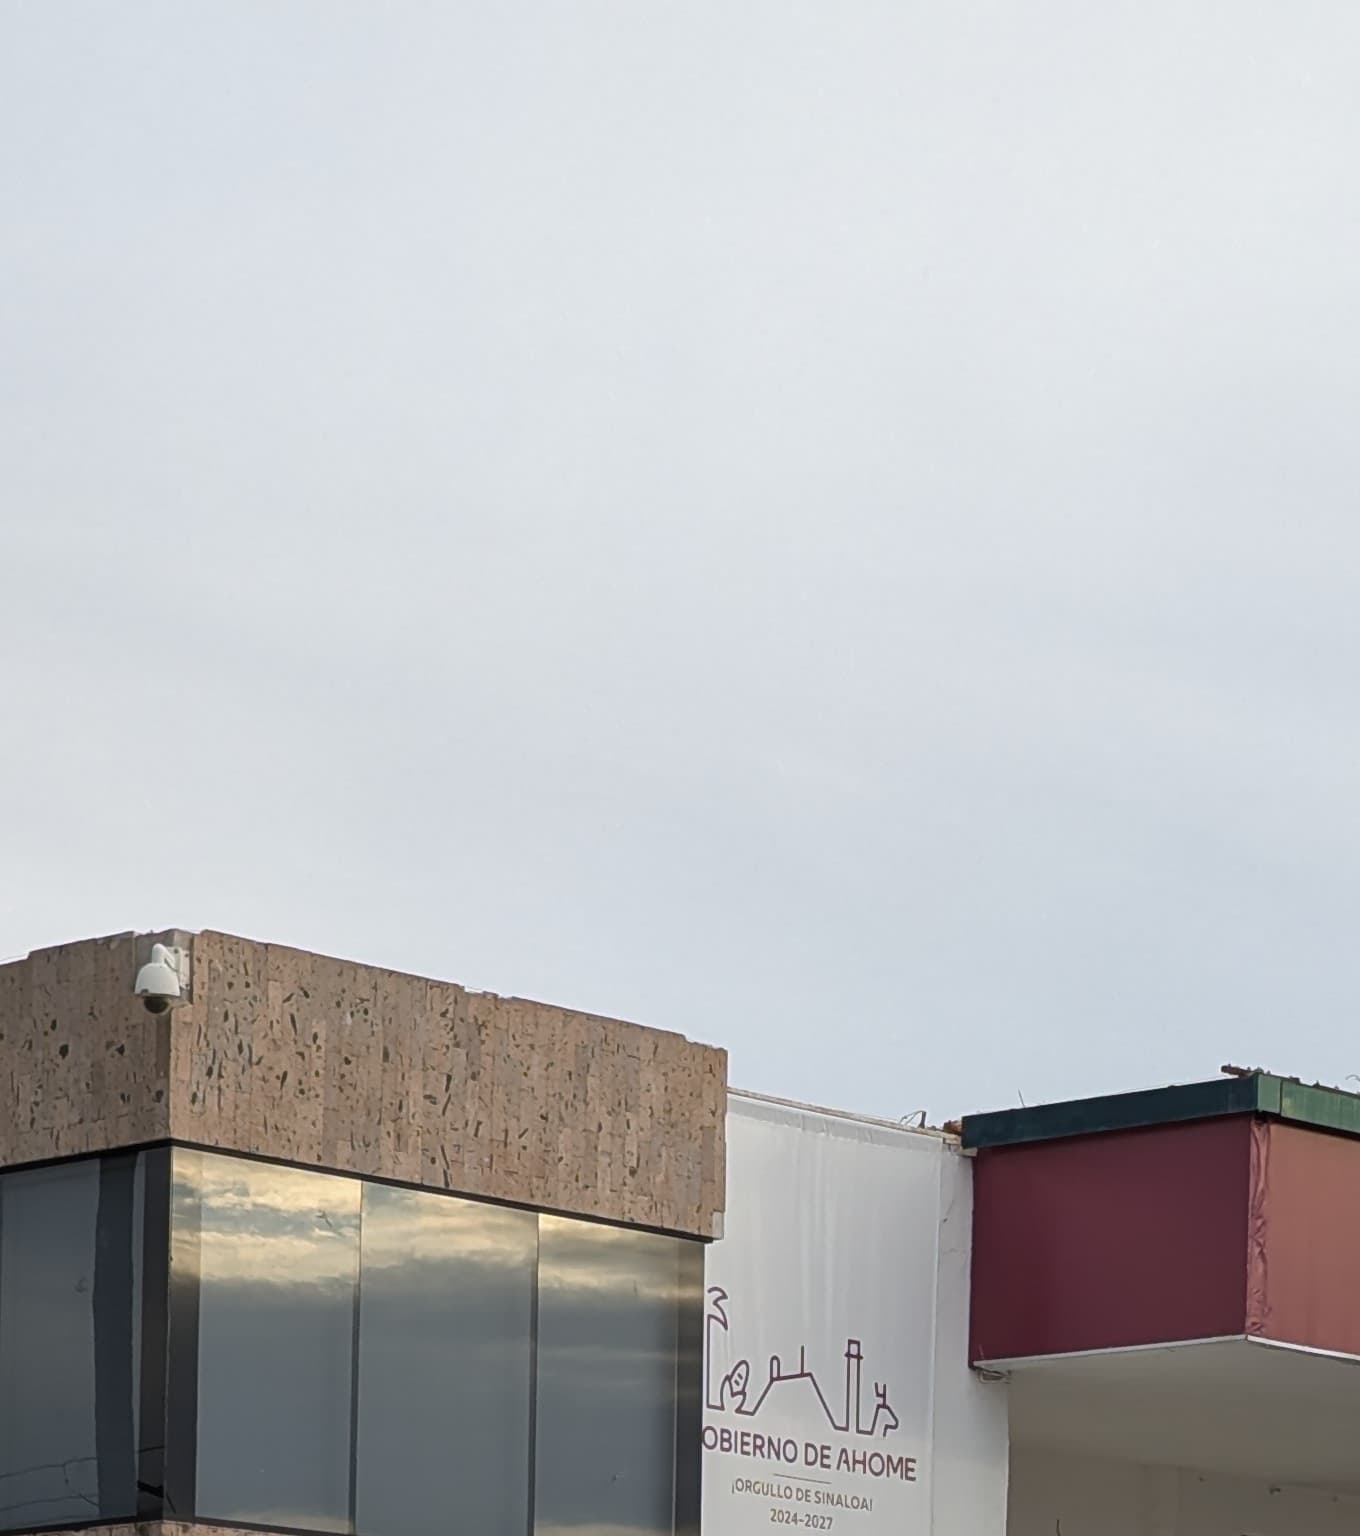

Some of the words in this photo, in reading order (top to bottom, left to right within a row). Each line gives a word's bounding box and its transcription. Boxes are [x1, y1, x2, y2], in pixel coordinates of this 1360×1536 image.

[702, 1425, 798, 1463] OBIERNO
[804, 1442, 832, 1470] DE
[836, 1447, 918, 1482] AHOME
[731, 1478, 793, 1501] ¡ORGULLO
[796, 1487, 812, 1504] DE
[814, 1489, 874, 1512] SINALOA!
[770, 1508, 834, 1531] 2024-2027
